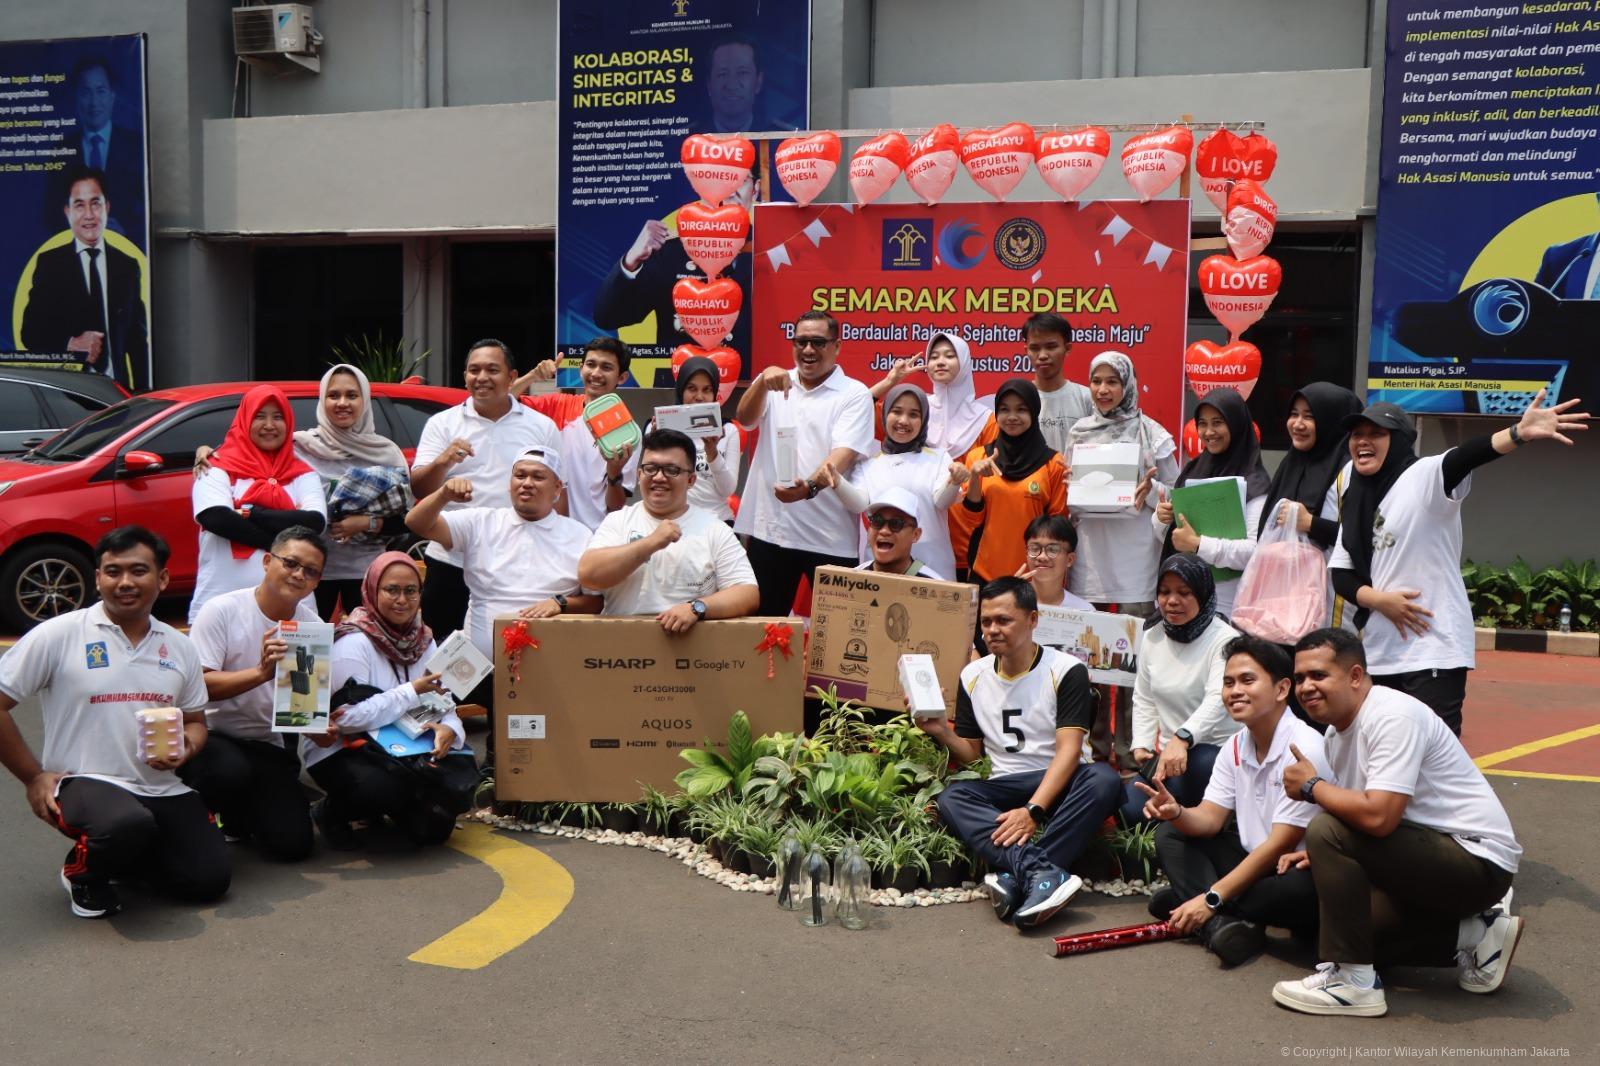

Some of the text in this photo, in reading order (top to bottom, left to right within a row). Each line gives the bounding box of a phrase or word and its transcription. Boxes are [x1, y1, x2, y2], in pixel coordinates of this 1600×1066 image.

[1407, 9, 1441, 21] untuk
[1443, 6, 1519, 19] membangun
[1522, 1, 1592, 14] kesadaran,
[1405, 27, 1489, 43] implementasi
[1491, 23, 1552, 37] nilai-nilai
[1554, 21, 1579, 33] Hak
[574, 48, 693, 69] KOLABORASI,
[1404, 51, 1416, 62] di
[1419, 49, 1461, 63] tengah
[1463, 46, 1538, 60] masyarakat
[1540, 44, 1564, 56] dan
[573, 67, 693, 88] SINERGITAS &
[1403, 63, 1585, 85] Dengan semangat kolaborasi,
[574, 89, 675, 108] INTEGRITAS
[1402, 92, 1425, 103] kita
[1427, 89, 1508, 102] berkomitmen
[1510, 85, 1593, 99] menciptakan
[652, 117, 675, 126] sinergi
[676, 116, 689, 124] dan
[1400, 104, 1600, 125] yang inklusif, adil, dan berkeadil
[573, 128, 689, 140] integritas dalam menjalankan tugas
[1400, 127, 1597, 143] Bersama, mari wujudkan budaya
[573, 142, 595, 150] adalah
[596, 142, 626, 150] tanggung
[627, 140, 647, 149] jawab
[910, 134, 935, 157] OVE
[963, 136, 1023, 155] DIRGAHAYU
[1040, 133, 1095, 152] I LOVE
[573, 151, 664, 161] Kemenkumham bukan hanya
[690, 145, 743, 162] I LOVE
[1399, 148, 1577, 165] menghormati dan melindungi
[573, 164, 596, 172] sebuah
[597, 163, 624, 171] institusi
[625, 162, 645, 171] tetapi
[646, 161, 668, 170] adalah
[971, 154, 1017, 169] REPUBLIK
[1042, 159, 1092, 173] INDONESIA
[1211, 157, 1263, 175] I LOVE
[604, 175, 621, 183] yang
[642, 173, 672, 182] bergerak
[1398, 173, 1420, 183] Hak
[1422, 172, 1457, 183] Asasi
[1459, 171, 1511, 182] Manusia
[1513, 170, 1548, 181] untuk
[613, 186, 630, 194] yang
[573, 198, 596, 206] dengan
[597, 197, 618, 205] tujuan
[619, 197, 634, 205] yang
[680, 221, 741, 232] DIRGAHAYU
[687, 240, 733, 248] REPUBLIK
[1209, 273, 1268, 289] I LOVE
[674, 299, 729, 309] DIRGAHAYU
[812, 287, 1118, 313] SEMARAK MERDEKA
[1209, 301, 1264, 312] INDONESIA
[842, 324, 908, 341] Berdaulat
[963, 325, 1026, 346] Sejahter
[1110, 325, 1150, 346] Maju"
[632, 347, 653, 355] Agtas,
[1186, 364, 1246, 375] DIRGAHAYU
[1384, 366, 1421, 374] Natalius
[1422, 366, 1446, 376] Pigai,
[1384, 380, 1501, 390] Menteri Hak Asasi Manusia
[831, 575, 880, 591] Miyako
[854, 643, 860, 652] 3
[584, 658, 745, 671] SHARP Google TV
[641, 719, 692, 731] AQUOS
[1002, 709, 1025, 752] 5
